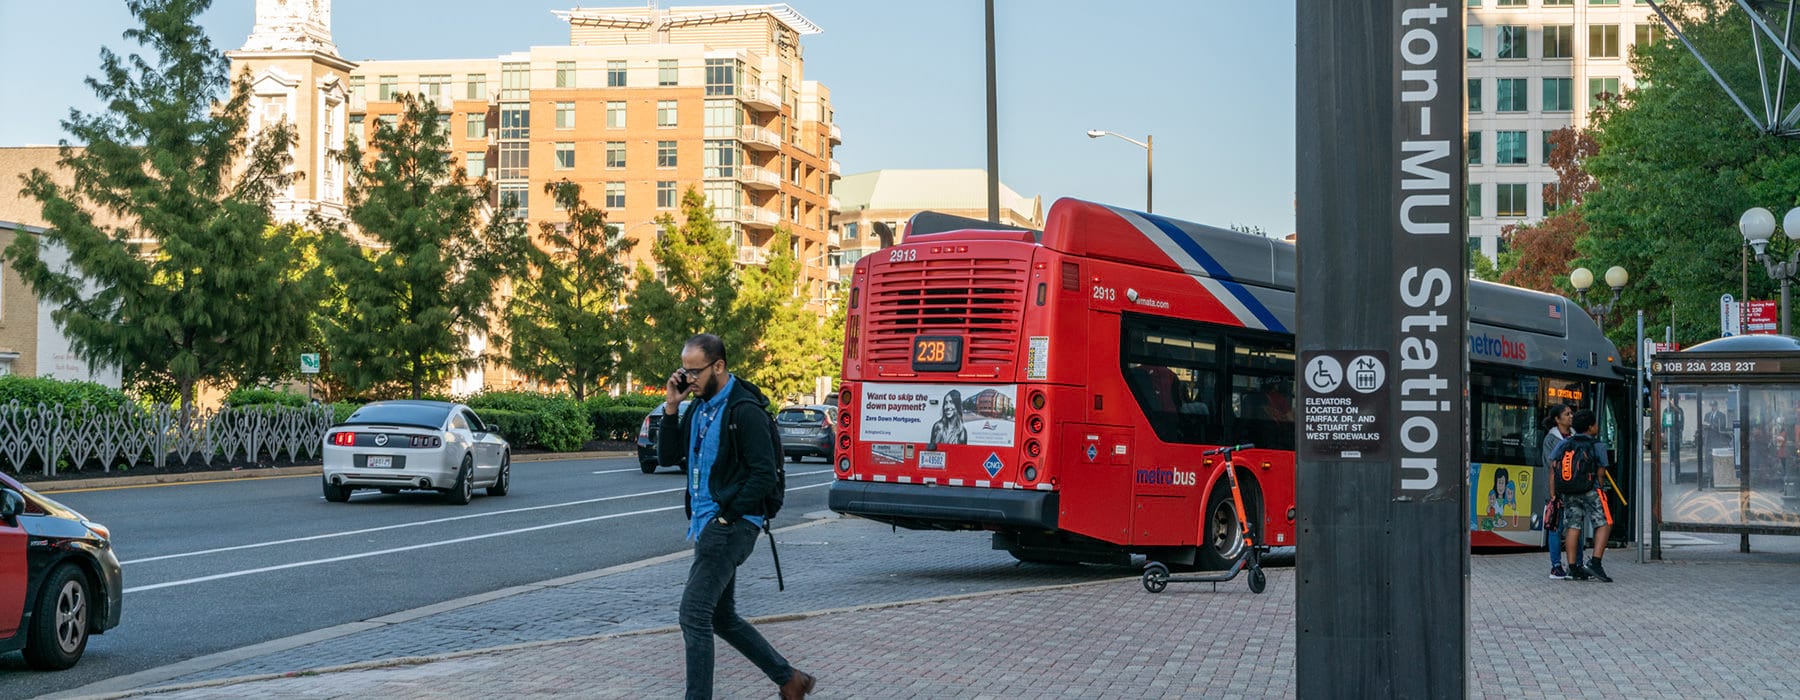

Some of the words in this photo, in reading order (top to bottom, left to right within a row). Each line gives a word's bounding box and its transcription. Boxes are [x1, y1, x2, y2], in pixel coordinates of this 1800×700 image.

[1400, 3, 1450, 234] ton-MU
[890, 249, 917, 262] 2913
[1093, 285, 1115, 301] 2913
[917, 341, 945, 362] 23B
[1664, 362, 1682, 372] 10B
[1687, 362, 1706, 371] 23A
[1710, 362, 1731, 371] 23B
[1735, 362, 1755, 371] 23T
[1400, 266, 1452, 490] Station
[867, 392, 887, 400] Want
[898, 394, 914, 402] skip
[1305, 397, 1352, 406] ELEVATORS
[866, 401, 886, 410] down
[888, 403, 926, 412] payment?
[1305, 406, 1343, 414] LOCATED
[1345, 406, 1359, 414] ON
[1305, 415, 1338, 423] FAIRFAX
[1341, 415, 1355, 423] DR.
[1358, 415, 1376, 423] AND
[1305, 424, 1314, 432] N.
[1317, 424, 1349, 432] STUART
[1351, 424, 1363, 432] ST
[1306, 432, 1330, 440] WEST
[1332, 432, 1380, 440] SIDEWALKS
[986, 461, 1001, 469] CNG
[1136, 466, 1196, 486] metrobus
